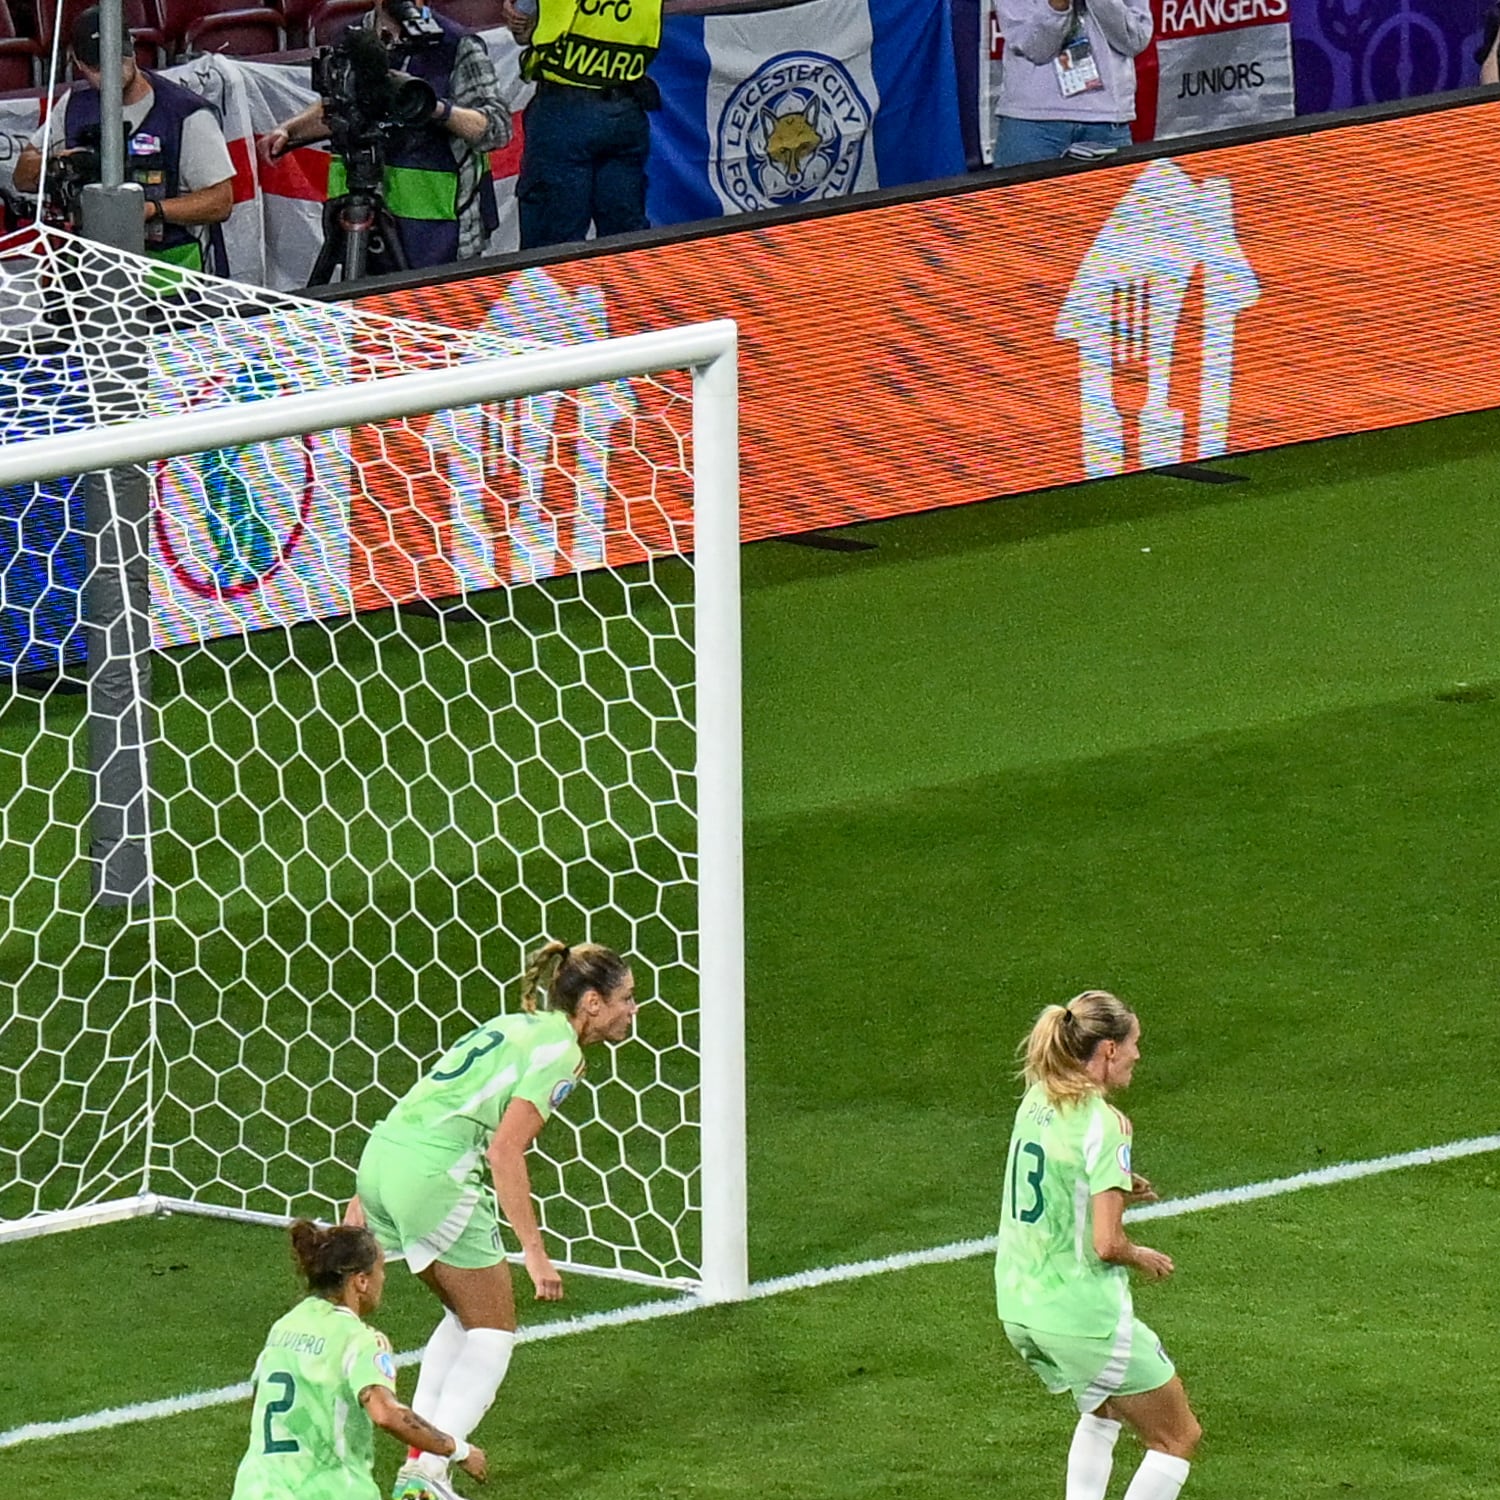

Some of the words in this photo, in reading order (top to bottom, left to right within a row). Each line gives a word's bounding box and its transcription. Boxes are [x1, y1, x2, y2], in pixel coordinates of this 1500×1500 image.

[727, 64, 824, 147] LEICESTER
[822, 74, 861, 125] CITY
[1177, 61, 1265, 99] JUNIORS
[1011, 1138, 1045, 1224] 13
[263, 1371, 300, 1455] 2
